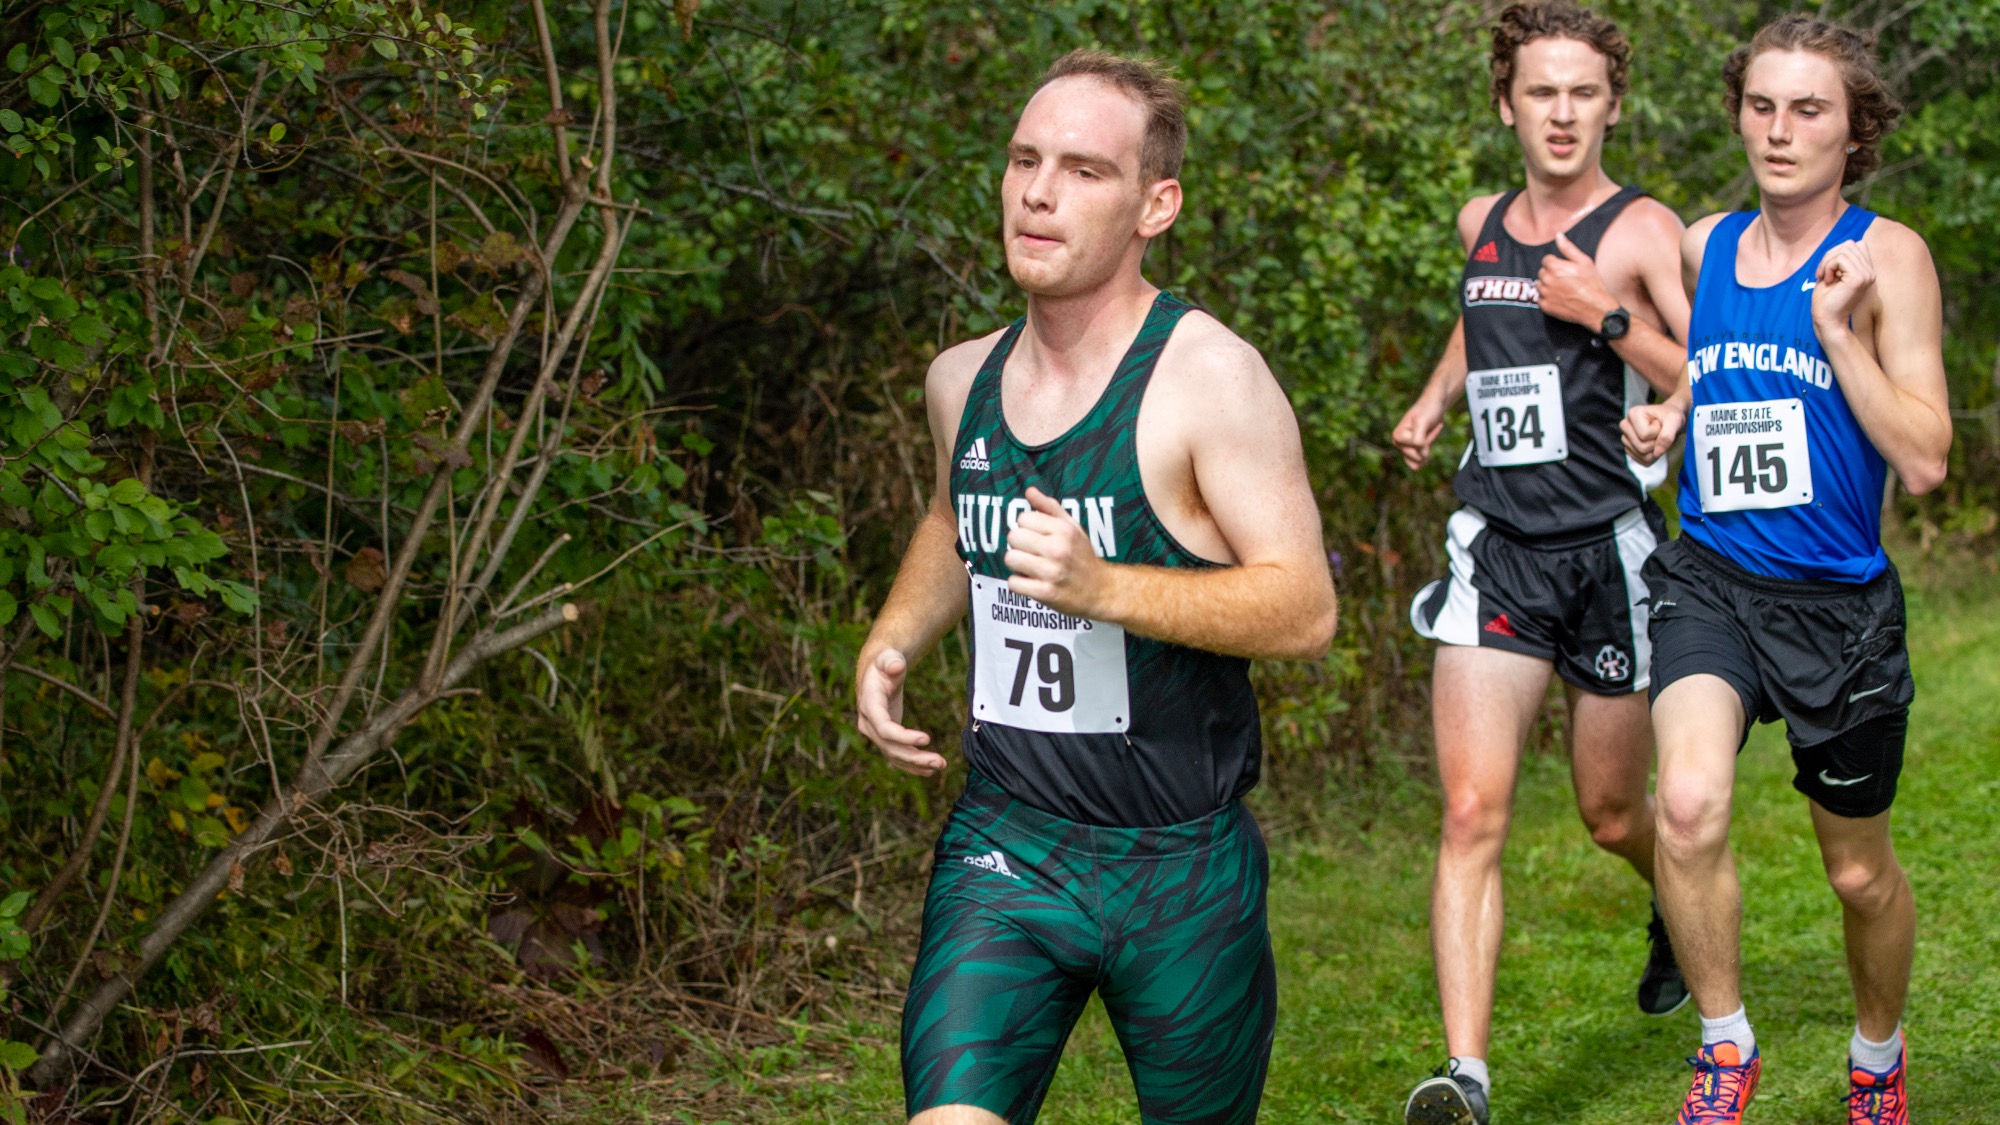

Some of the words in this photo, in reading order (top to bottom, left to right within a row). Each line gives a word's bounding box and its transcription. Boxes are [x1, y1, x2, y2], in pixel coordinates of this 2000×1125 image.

[1504, 372, 1531, 385] STATE
[1723, 341, 1833, 390] ENGLAND
[1481, 405, 1545, 452] 134
[1705, 419, 1783, 437] CHAMPIONSHIPS
[1711, 408, 1738, 421] MAINE
[1741, 407, 1772, 420] STATE
[960, 457, 990, 471] addas
[1707, 442, 1788, 496] 145
[957, 494, 1117, 558] HUN
[992, 604, 1093, 630] CHAMPIONSHIPS
[1004, 637, 1076, 713] 79
